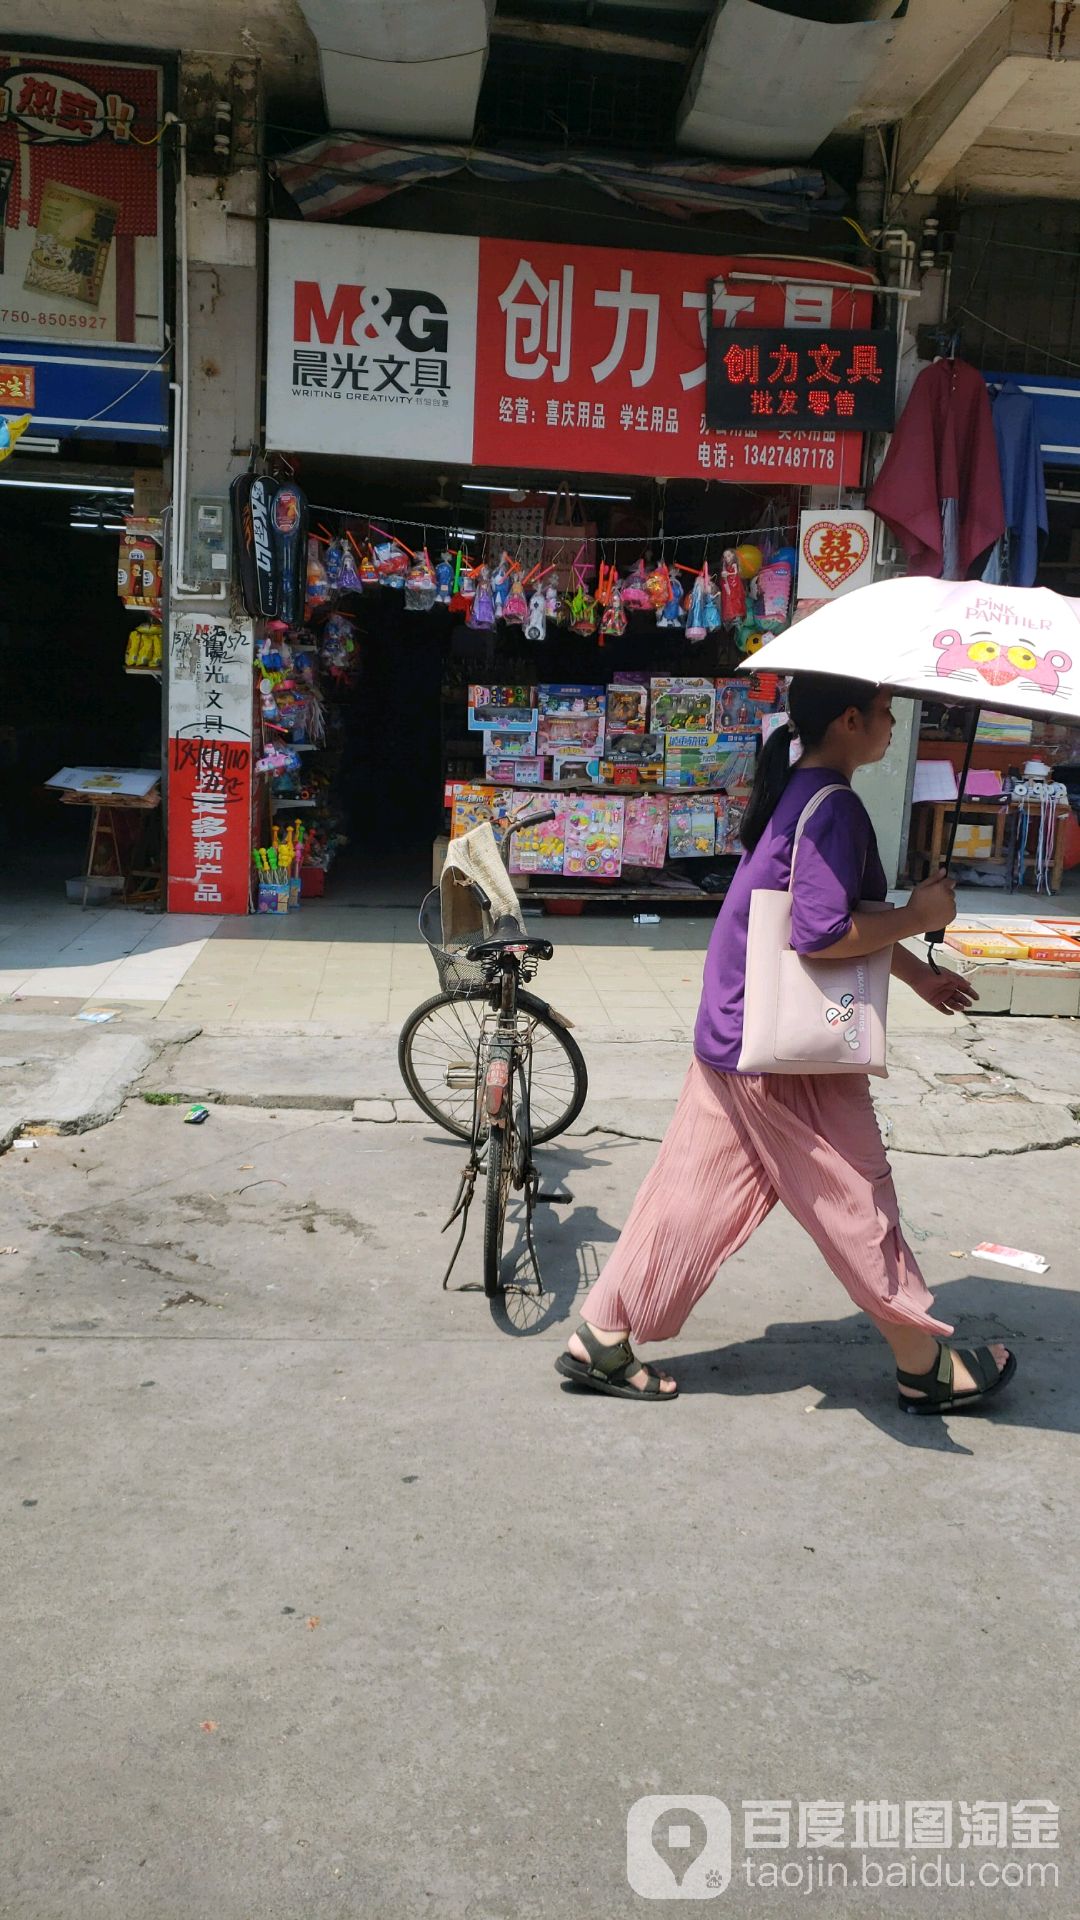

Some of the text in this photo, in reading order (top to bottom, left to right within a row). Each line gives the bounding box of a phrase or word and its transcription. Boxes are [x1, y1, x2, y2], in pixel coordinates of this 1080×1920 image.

[293, 280, 449, 353] M&G
[292, 350, 451, 397] 晨光文具
[723, 344, 883, 385] 创力文具
[291, 388, 414, 405] WRITING CREATIVITY
[750, 390, 855, 416] 批发 零售
[619, 404, 680, 434] 学生用品
[965, 606, 1053, 630] PANTHER
